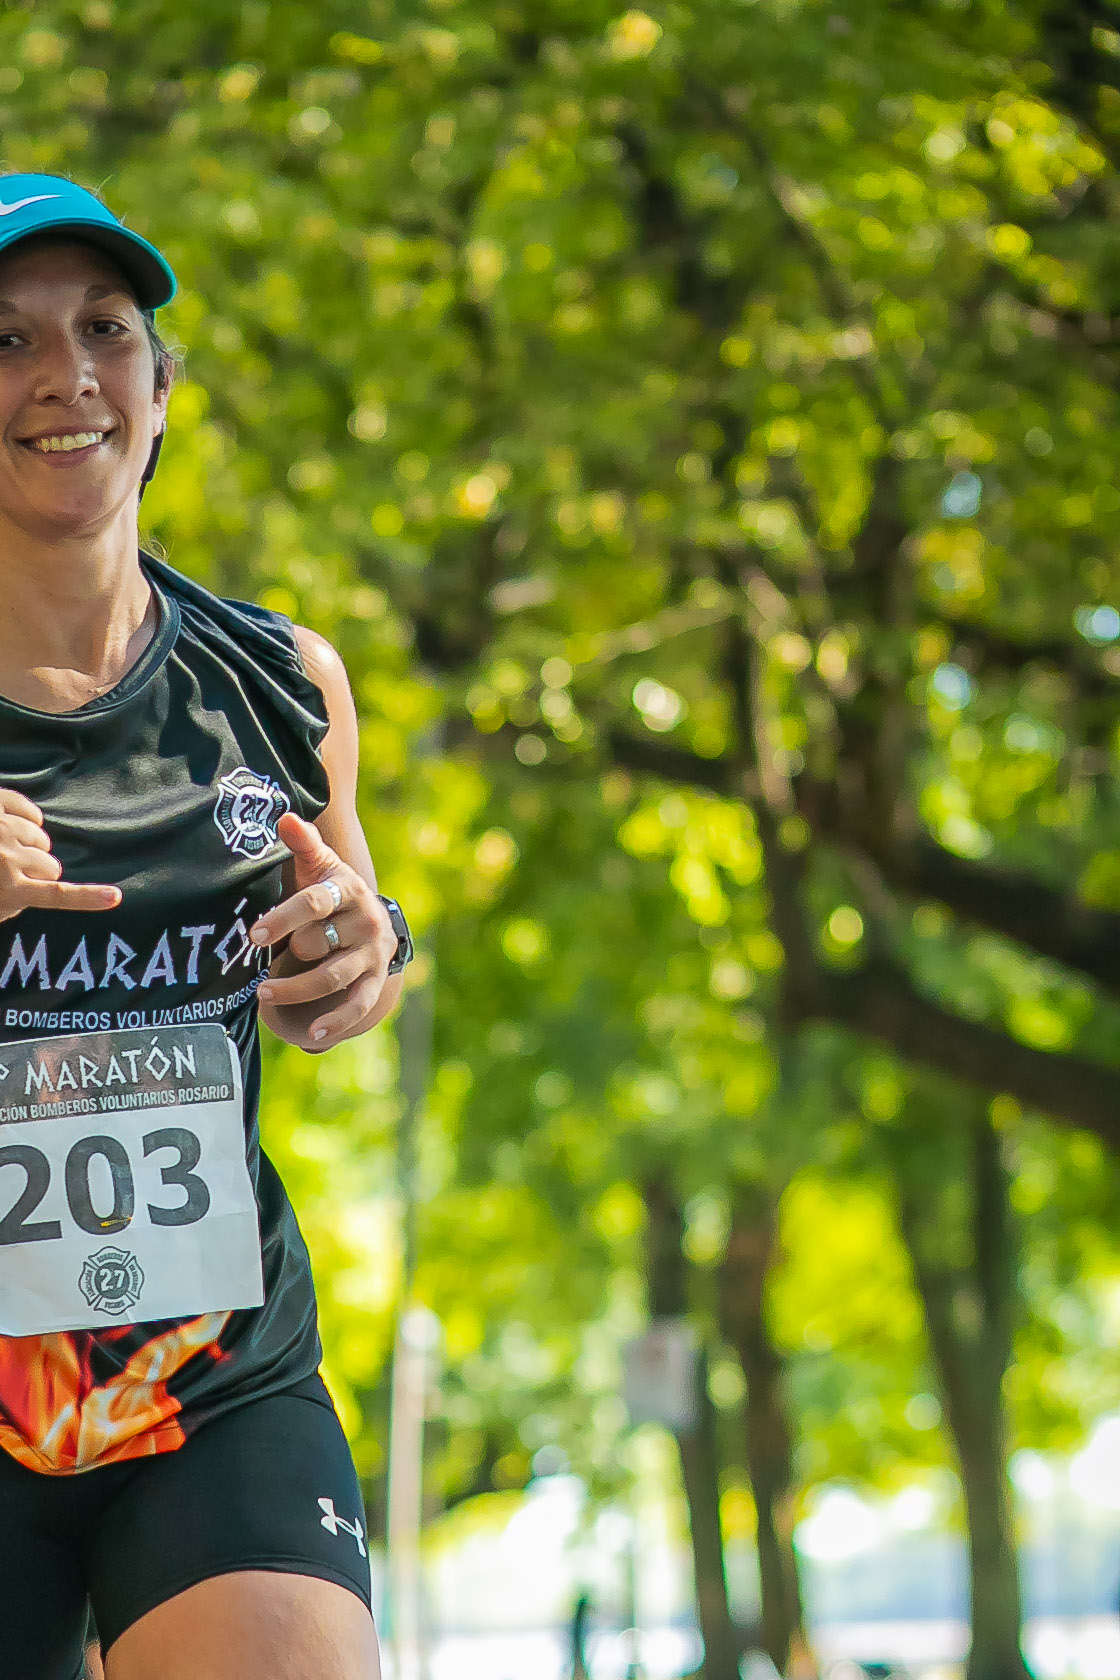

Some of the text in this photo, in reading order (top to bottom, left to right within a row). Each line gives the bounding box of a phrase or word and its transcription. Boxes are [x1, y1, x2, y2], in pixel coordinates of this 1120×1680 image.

[239, 793, 269, 825] 27
[4, 1008, 111, 1031] BOMBEROS
[116, 997, 224, 1029] VOLUNTARIOS
[24, 1035, 197, 1096] MARATÓN
[30, 1097, 98, 1119] BOMBEROS
[99, 1089, 176, 1111] VOLUNTARIOS
[177, 1084, 229, 1102] ROSARIO
[99, 1268, 126, 1292] 27
